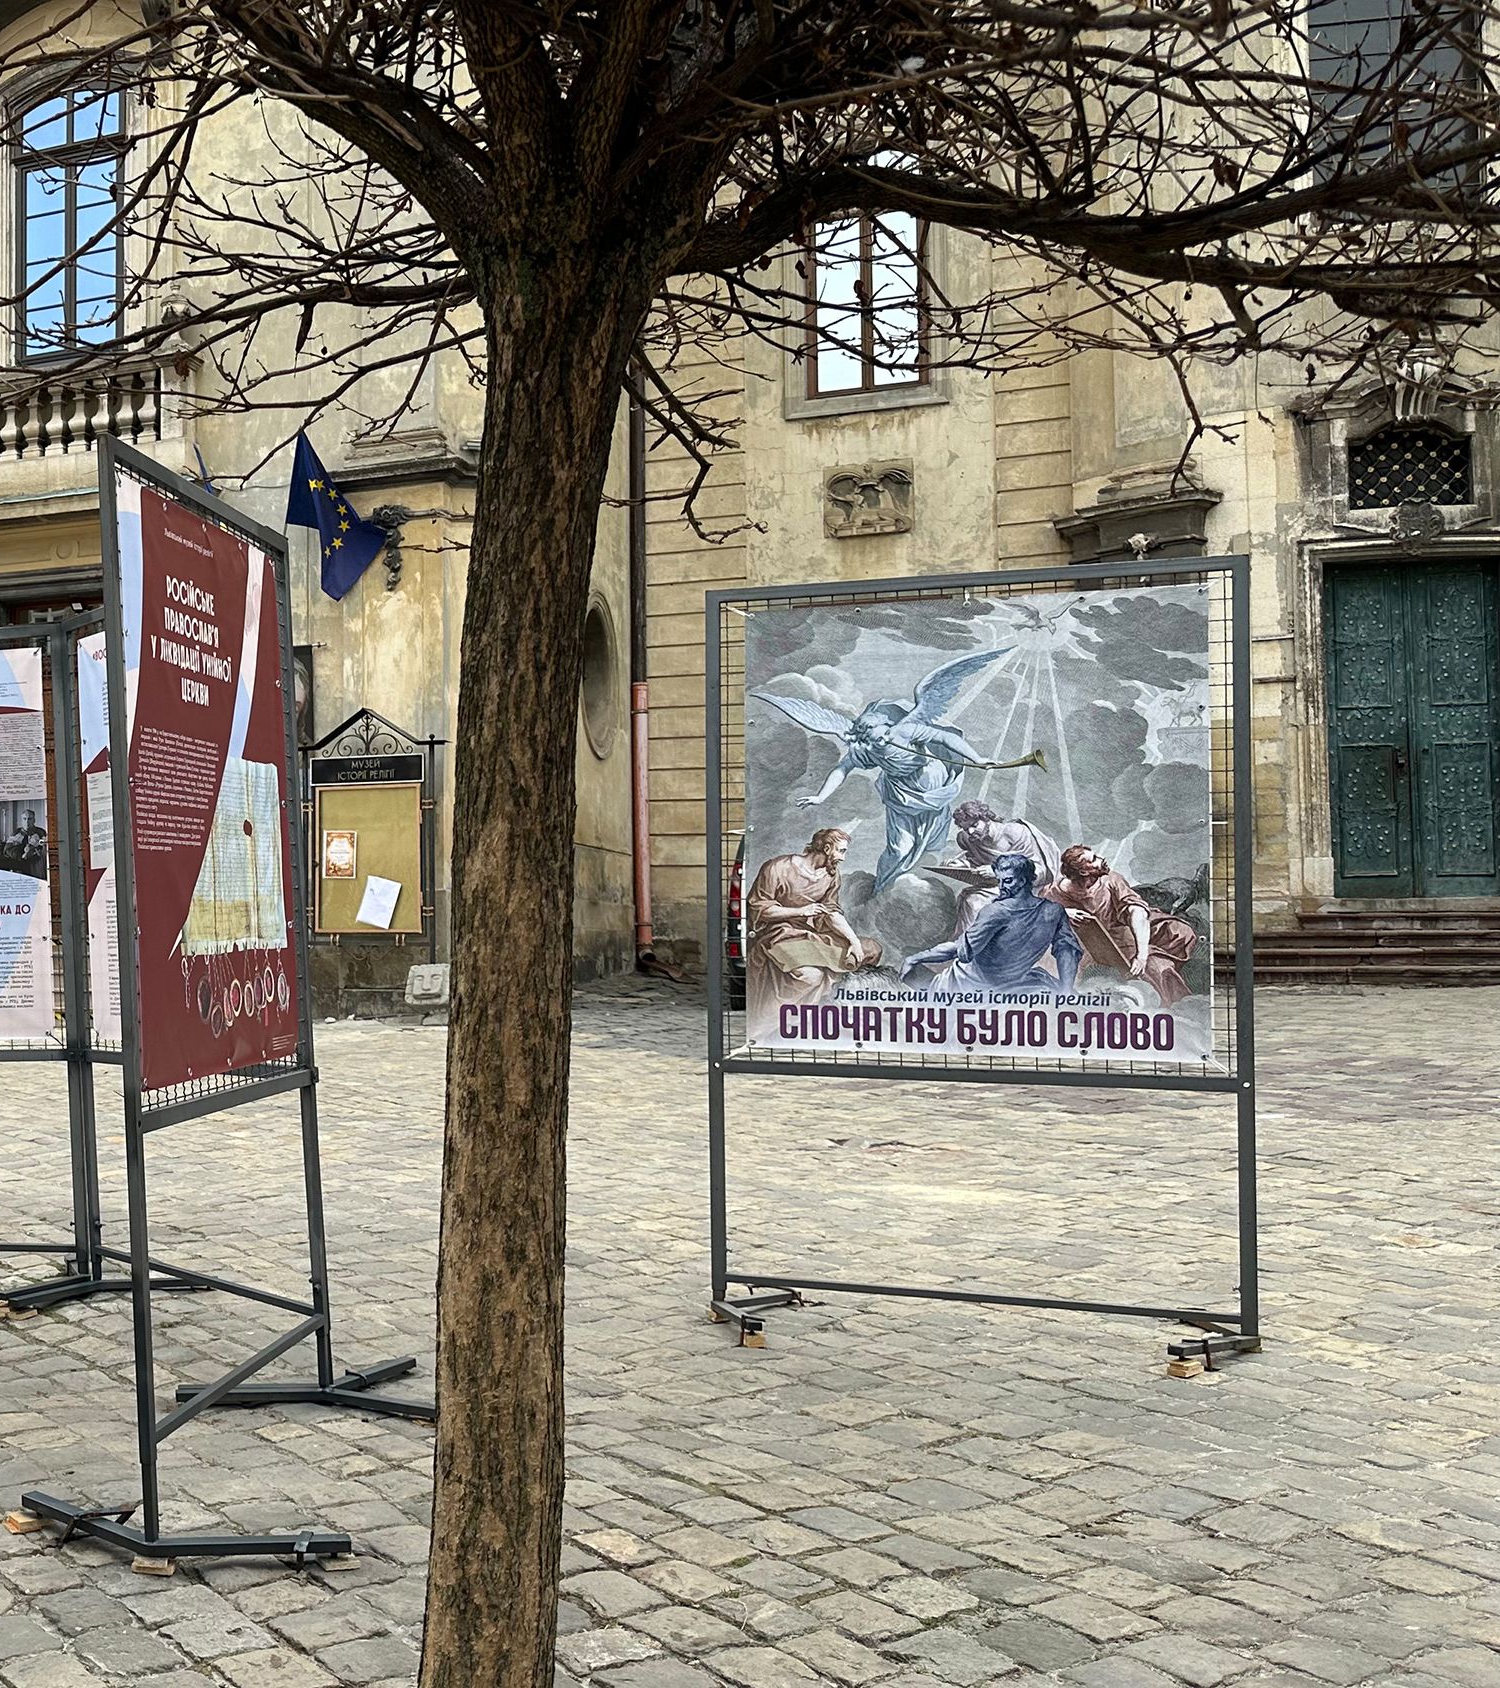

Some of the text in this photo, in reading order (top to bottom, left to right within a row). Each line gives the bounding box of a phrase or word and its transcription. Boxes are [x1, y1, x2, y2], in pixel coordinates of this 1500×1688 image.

[166, 574, 215, 616] РОСІЙСЬКЕ
[150, 634, 232, 682] У ЛІКВІДАЦІЇ УНІЙНОЇ
[181, 677, 210, 706] ЦЕРКВИ
[351, 758, 380, 769] МУЗЕЙ
[14, 904, 31, 915] ДО
[834, 988, 1112, 1009] Львівський музей історії релігії
[779, 1004, 1174, 1051] СПОЧАТКУ БУЛО СЛОВО
